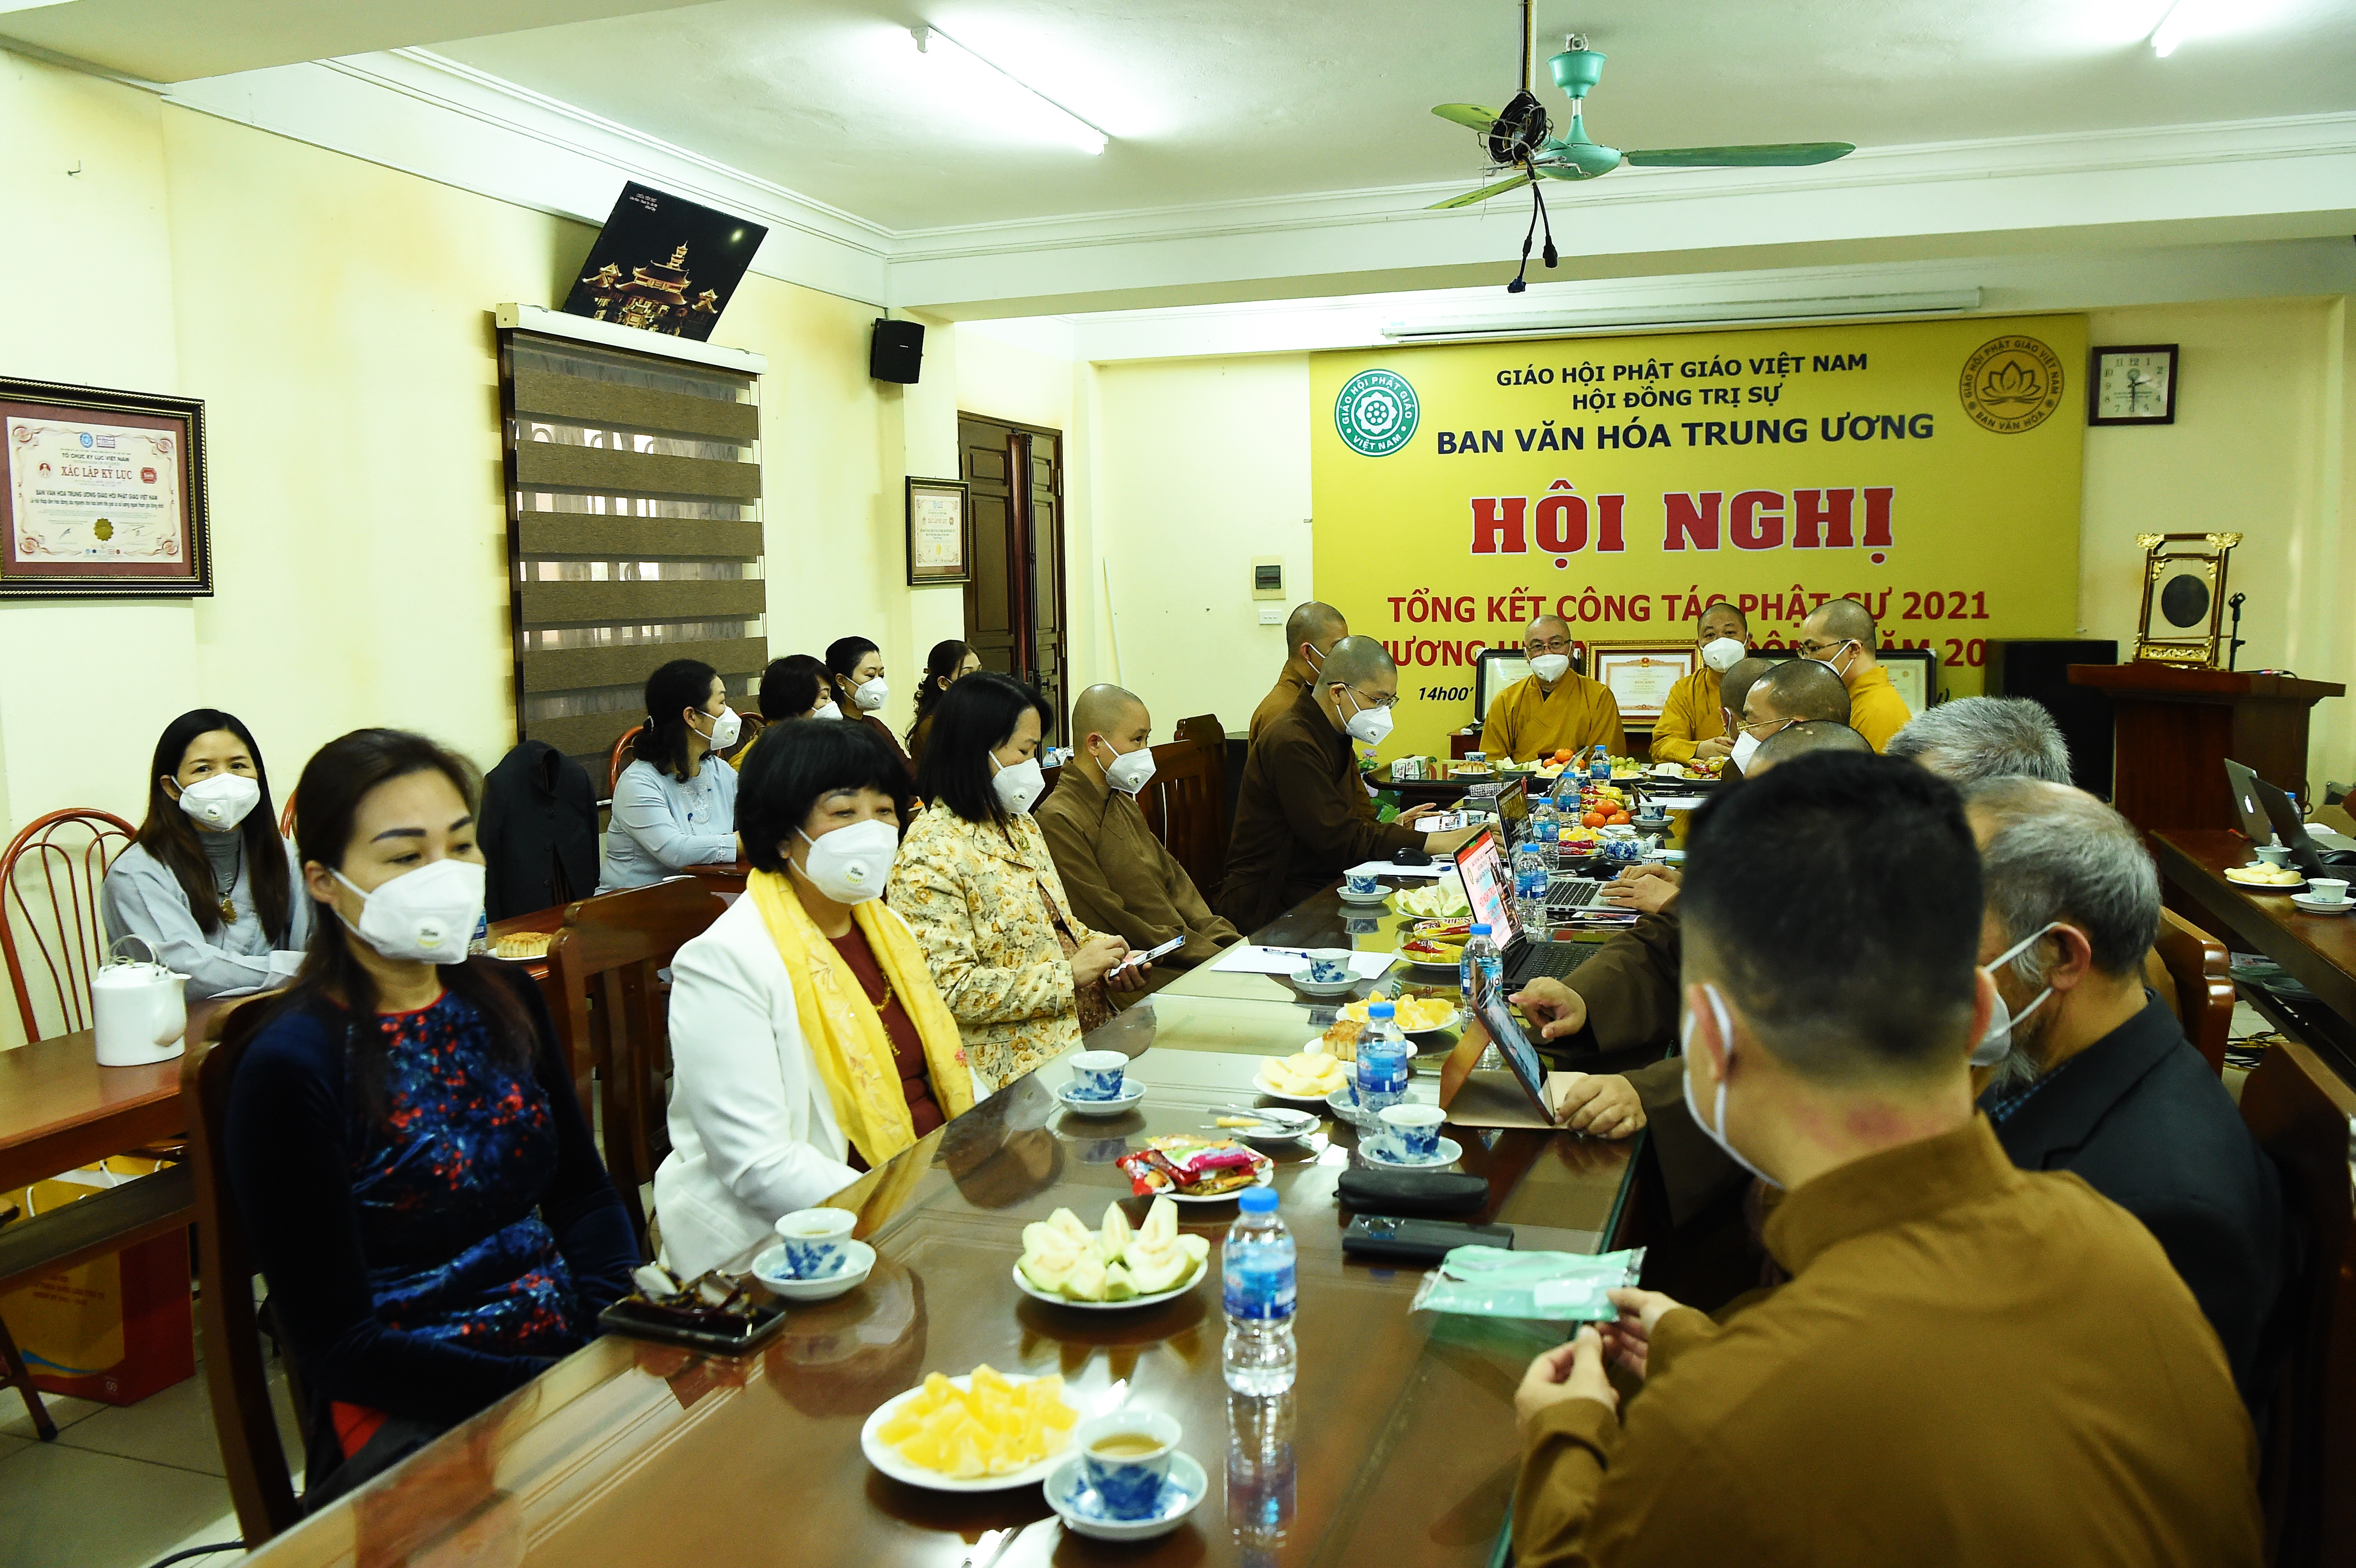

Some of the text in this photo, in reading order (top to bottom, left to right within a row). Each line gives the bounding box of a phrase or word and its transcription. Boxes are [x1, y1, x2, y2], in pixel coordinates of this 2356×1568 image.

[1497, 352, 1867, 387] GIÁO HỘI PHẬT GIÁO VIỆT NAM
[1340, 376, 1415, 425] GIÁO HỘI PHẬT GIÁO
[1573, 383, 1783, 413] HỘI ĐỒNG TRỊ SỰ
[1353, 434, 1402, 451] VIỆT NAM
[1438, 412, 1933, 454] BAN VĂN HÓA TRUNG ƯƠNG
[61, 464, 79, 477] XÁC
[82, 466, 98, 480] LẬP
[116, 469, 132, 481] LỤC
[1470, 479, 1896, 571] HỘI NGHỊ
[1387, 587, 1475, 623] TỔNG
[1487, 587, 1547, 622] KẾT
[1556, 586, 1650, 622] CÔNG
[1738, 584, 1831, 628] PHẬT
[1902, 591, 1989, 620] 2021
[1383, 635, 1485, 666] ƯƠNG
